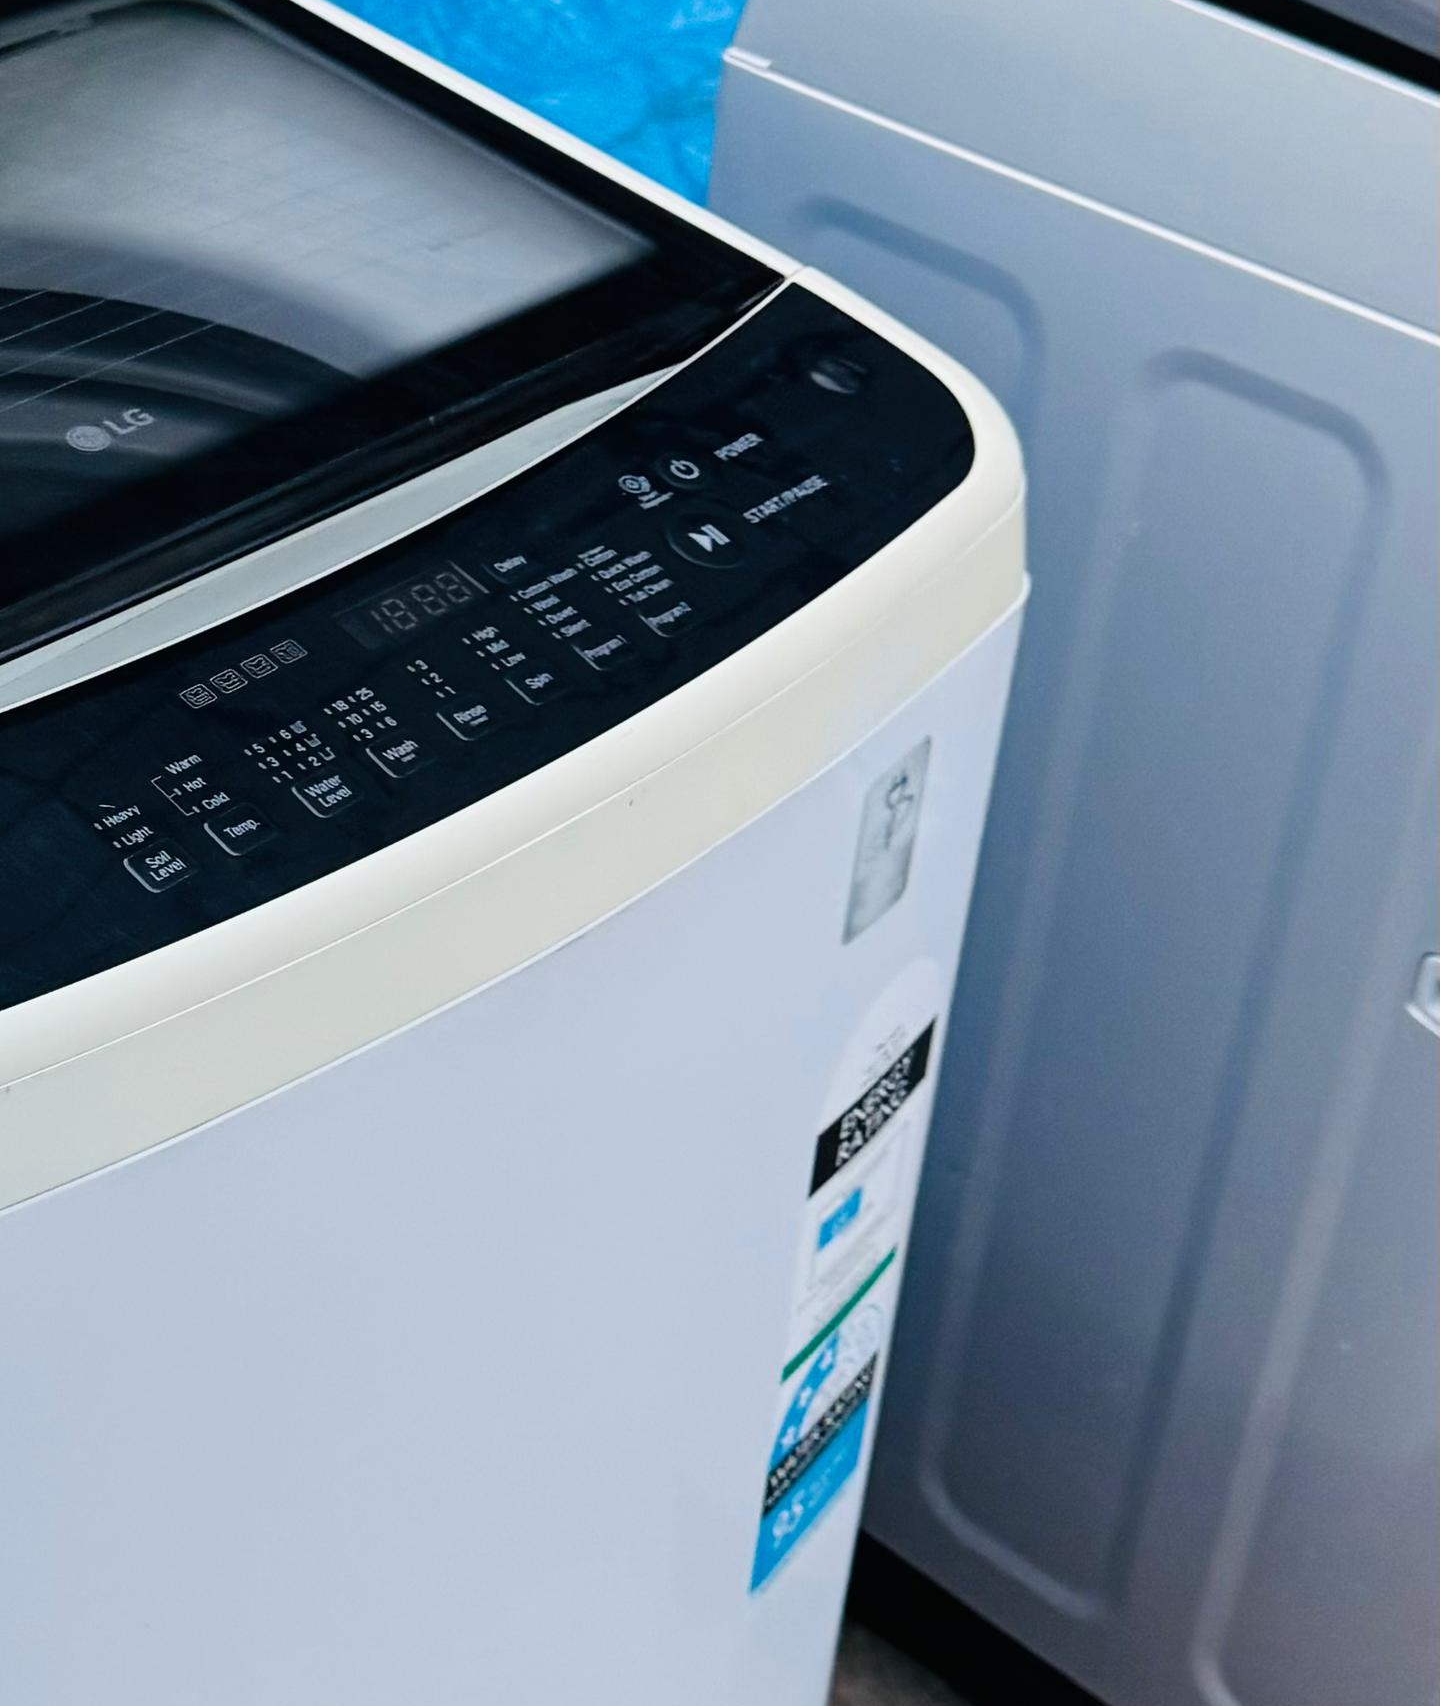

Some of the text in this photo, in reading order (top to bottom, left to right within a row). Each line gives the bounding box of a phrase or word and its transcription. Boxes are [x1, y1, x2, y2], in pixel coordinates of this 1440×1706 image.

[102, 407, 154, 435] LG
[713, 432, 764, 461] POWER
[743, 474, 830, 524] START/PAUSE
[493, 555, 527, 573] Delay
[472, 626, 499, 641] High
[486, 639, 510, 654] Mid
[415, 659, 428, 670] 3
[500, 652, 526, 667] Low
[429, 672, 443, 683] 2
[525, 673, 554, 690] Spin
[331, 687, 374, 712] 18 25
[444, 686, 456, 694] 1
[345, 701, 387, 725] 10 15
[453, 704, 487, 724] Rinse
[360, 716, 397, 739] 3 6
[251, 729, 292, 754] 5 6
[382, 740, 419, 761] Wash
[164, 754, 203, 775] Warm
[266, 743, 307, 767] 3 4
[281, 756, 322, 780] 1 2
[182, 777, 208, 793] Hot
[304, 775, 342, 798] Water
[201, 792, 231, 810] Cold
[318, 785, 353, 808] Level
[102, 805, 141, 828] Heavy
[121, 826, 154, 846] Light
[223, 819, 261, 838] Temp.
[145, 850, 172, 869] Soil
[150, 858, 187, 882] Level
